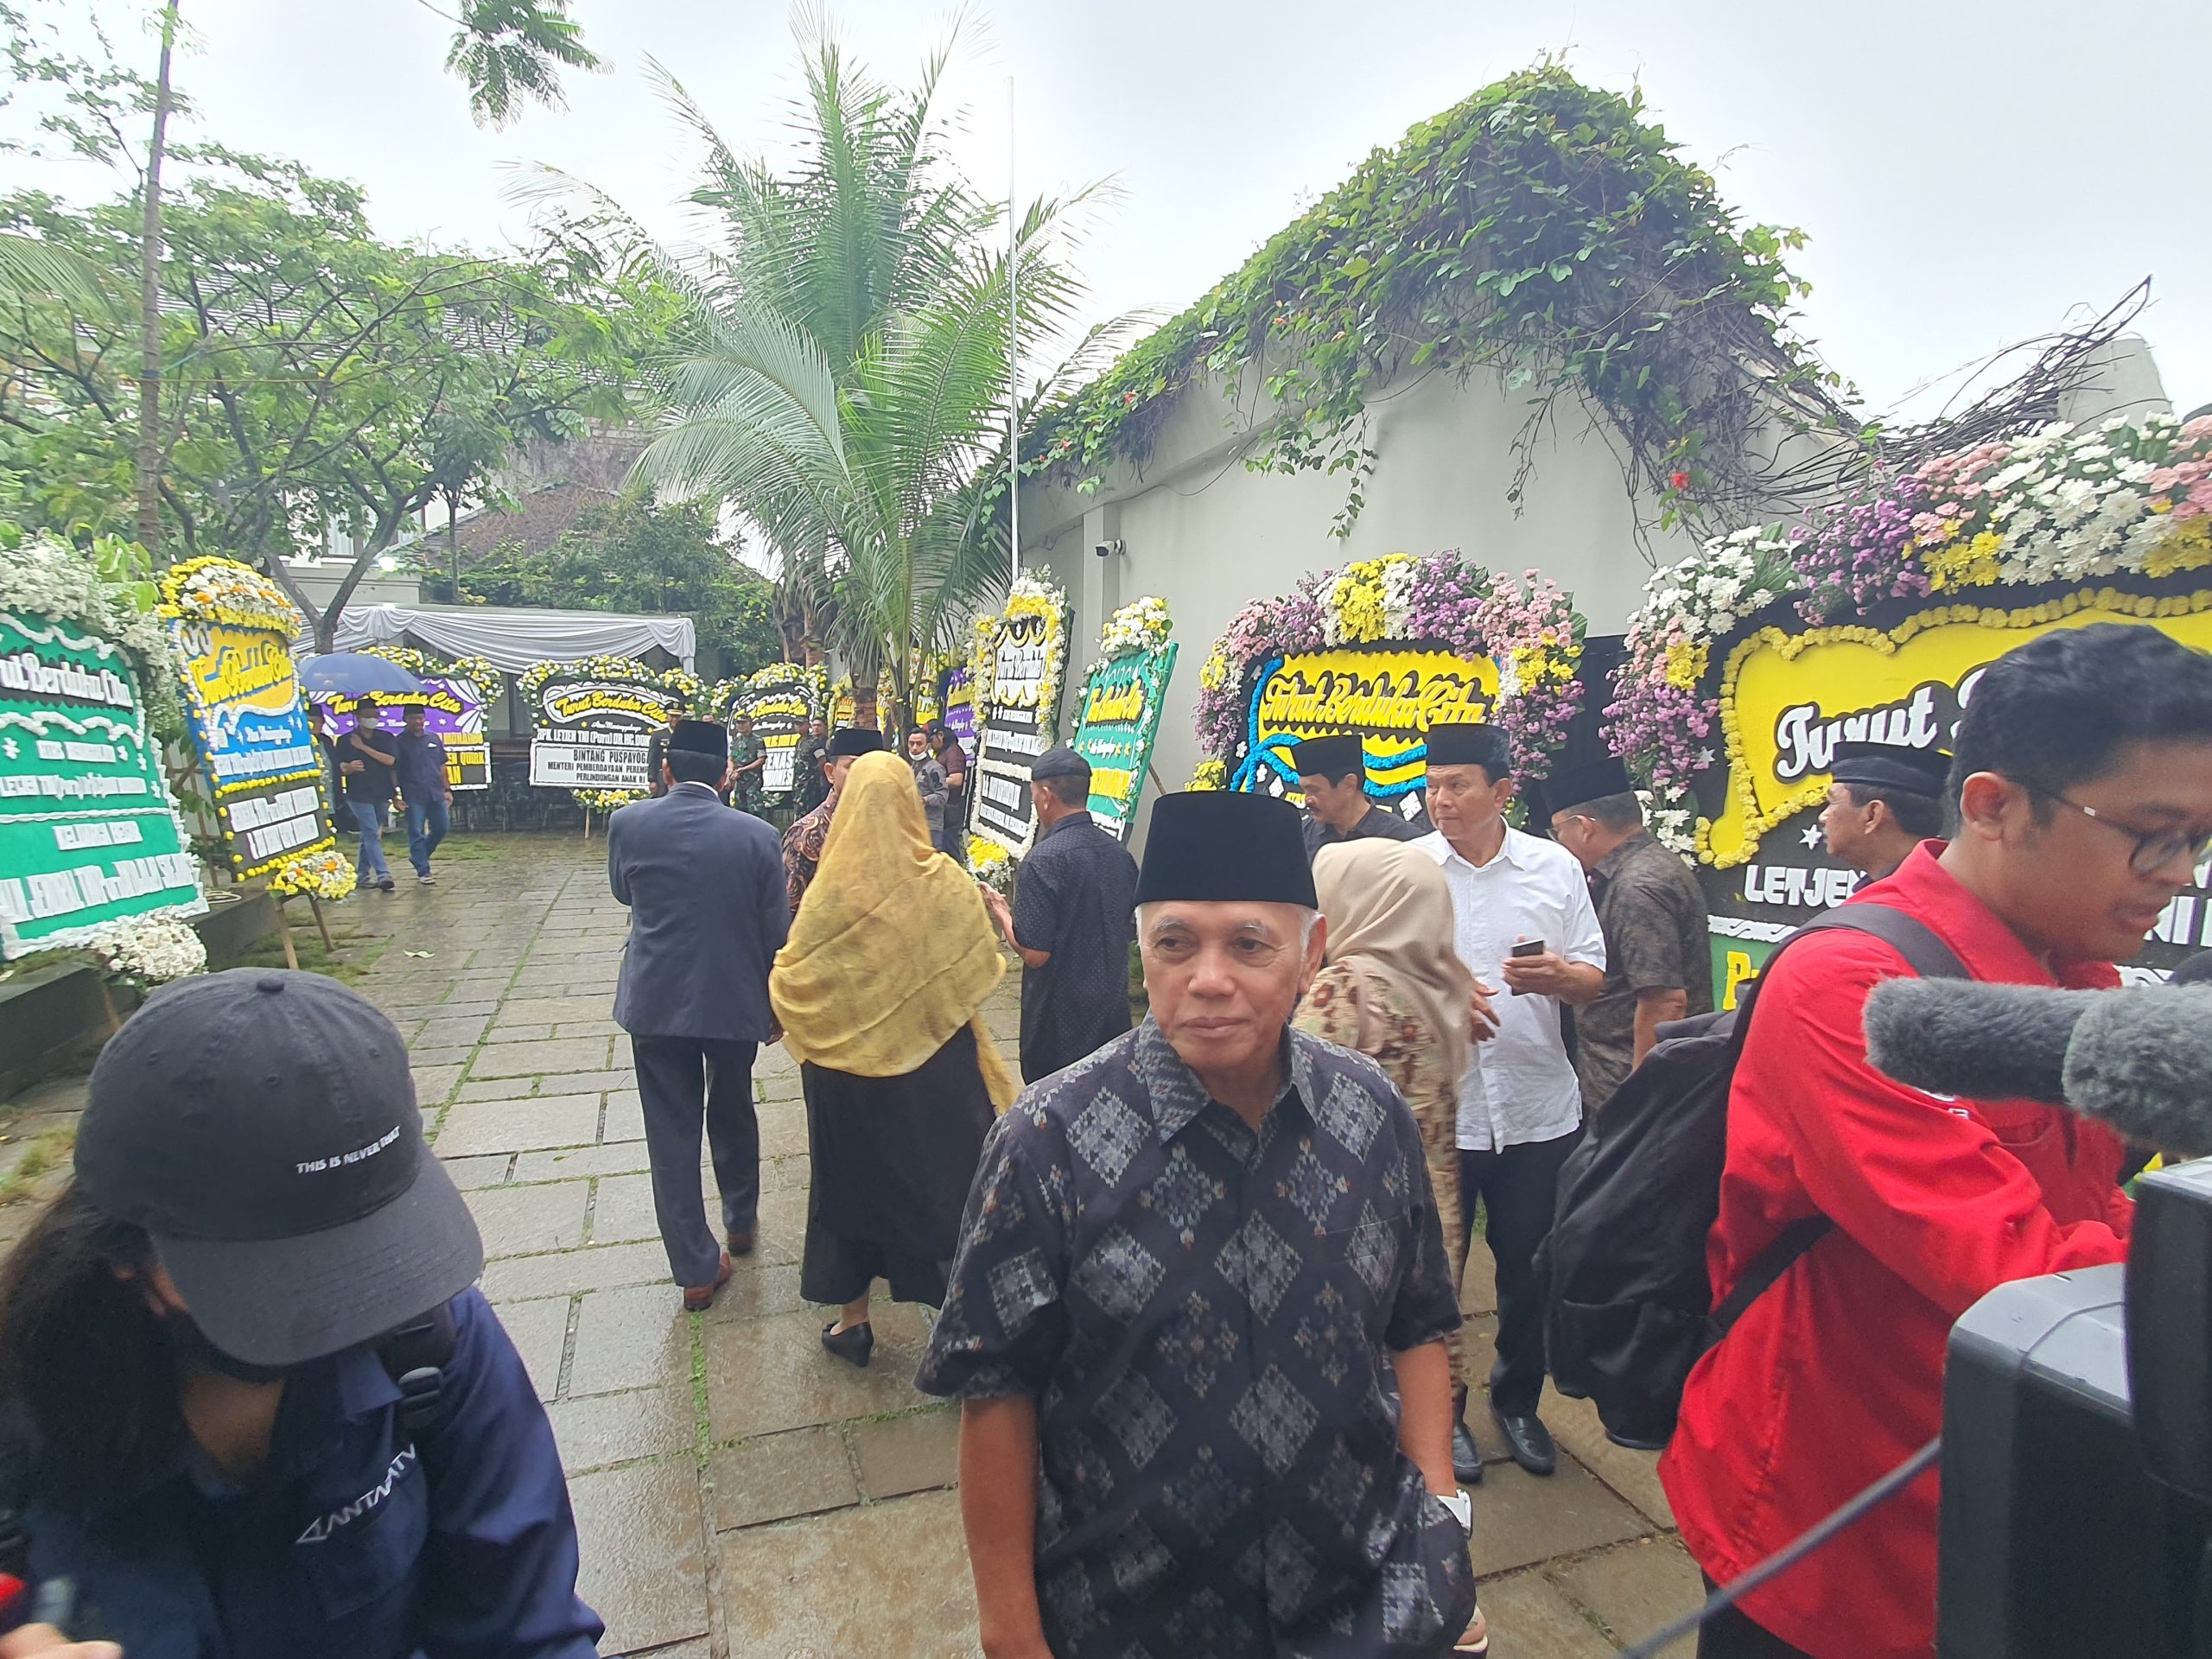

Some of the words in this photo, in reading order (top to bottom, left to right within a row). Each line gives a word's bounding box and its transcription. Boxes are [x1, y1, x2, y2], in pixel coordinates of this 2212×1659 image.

[556, 696, 592, 716] Turut
[591, 690, 642, 712] Berduka
[641, 702, 668, 722] Cita
[1325, 676, 1418, 728] Berduka
[1417, 679, 1486, 732] Cita
[1777, 686, 1938, 777] Turut
[548, 761, 574, 771] MENTERI
[576, 763, 623, 772] PEMBERDAYAAN
[574, 749, 605, 762] BINTANG
[609, 751, 649, 764] PUSPAYOG
[576, 772, 620, 782] PERLINDUNGAN
[621, 775, 637, 784] ANAK
[1745, 864, 1868, 908] LETJEN
[296, 1159, 327, 1174] THIS
[329, 1155, 341, 1168] IS
[343, 1141, 381, 1165] NEVER
